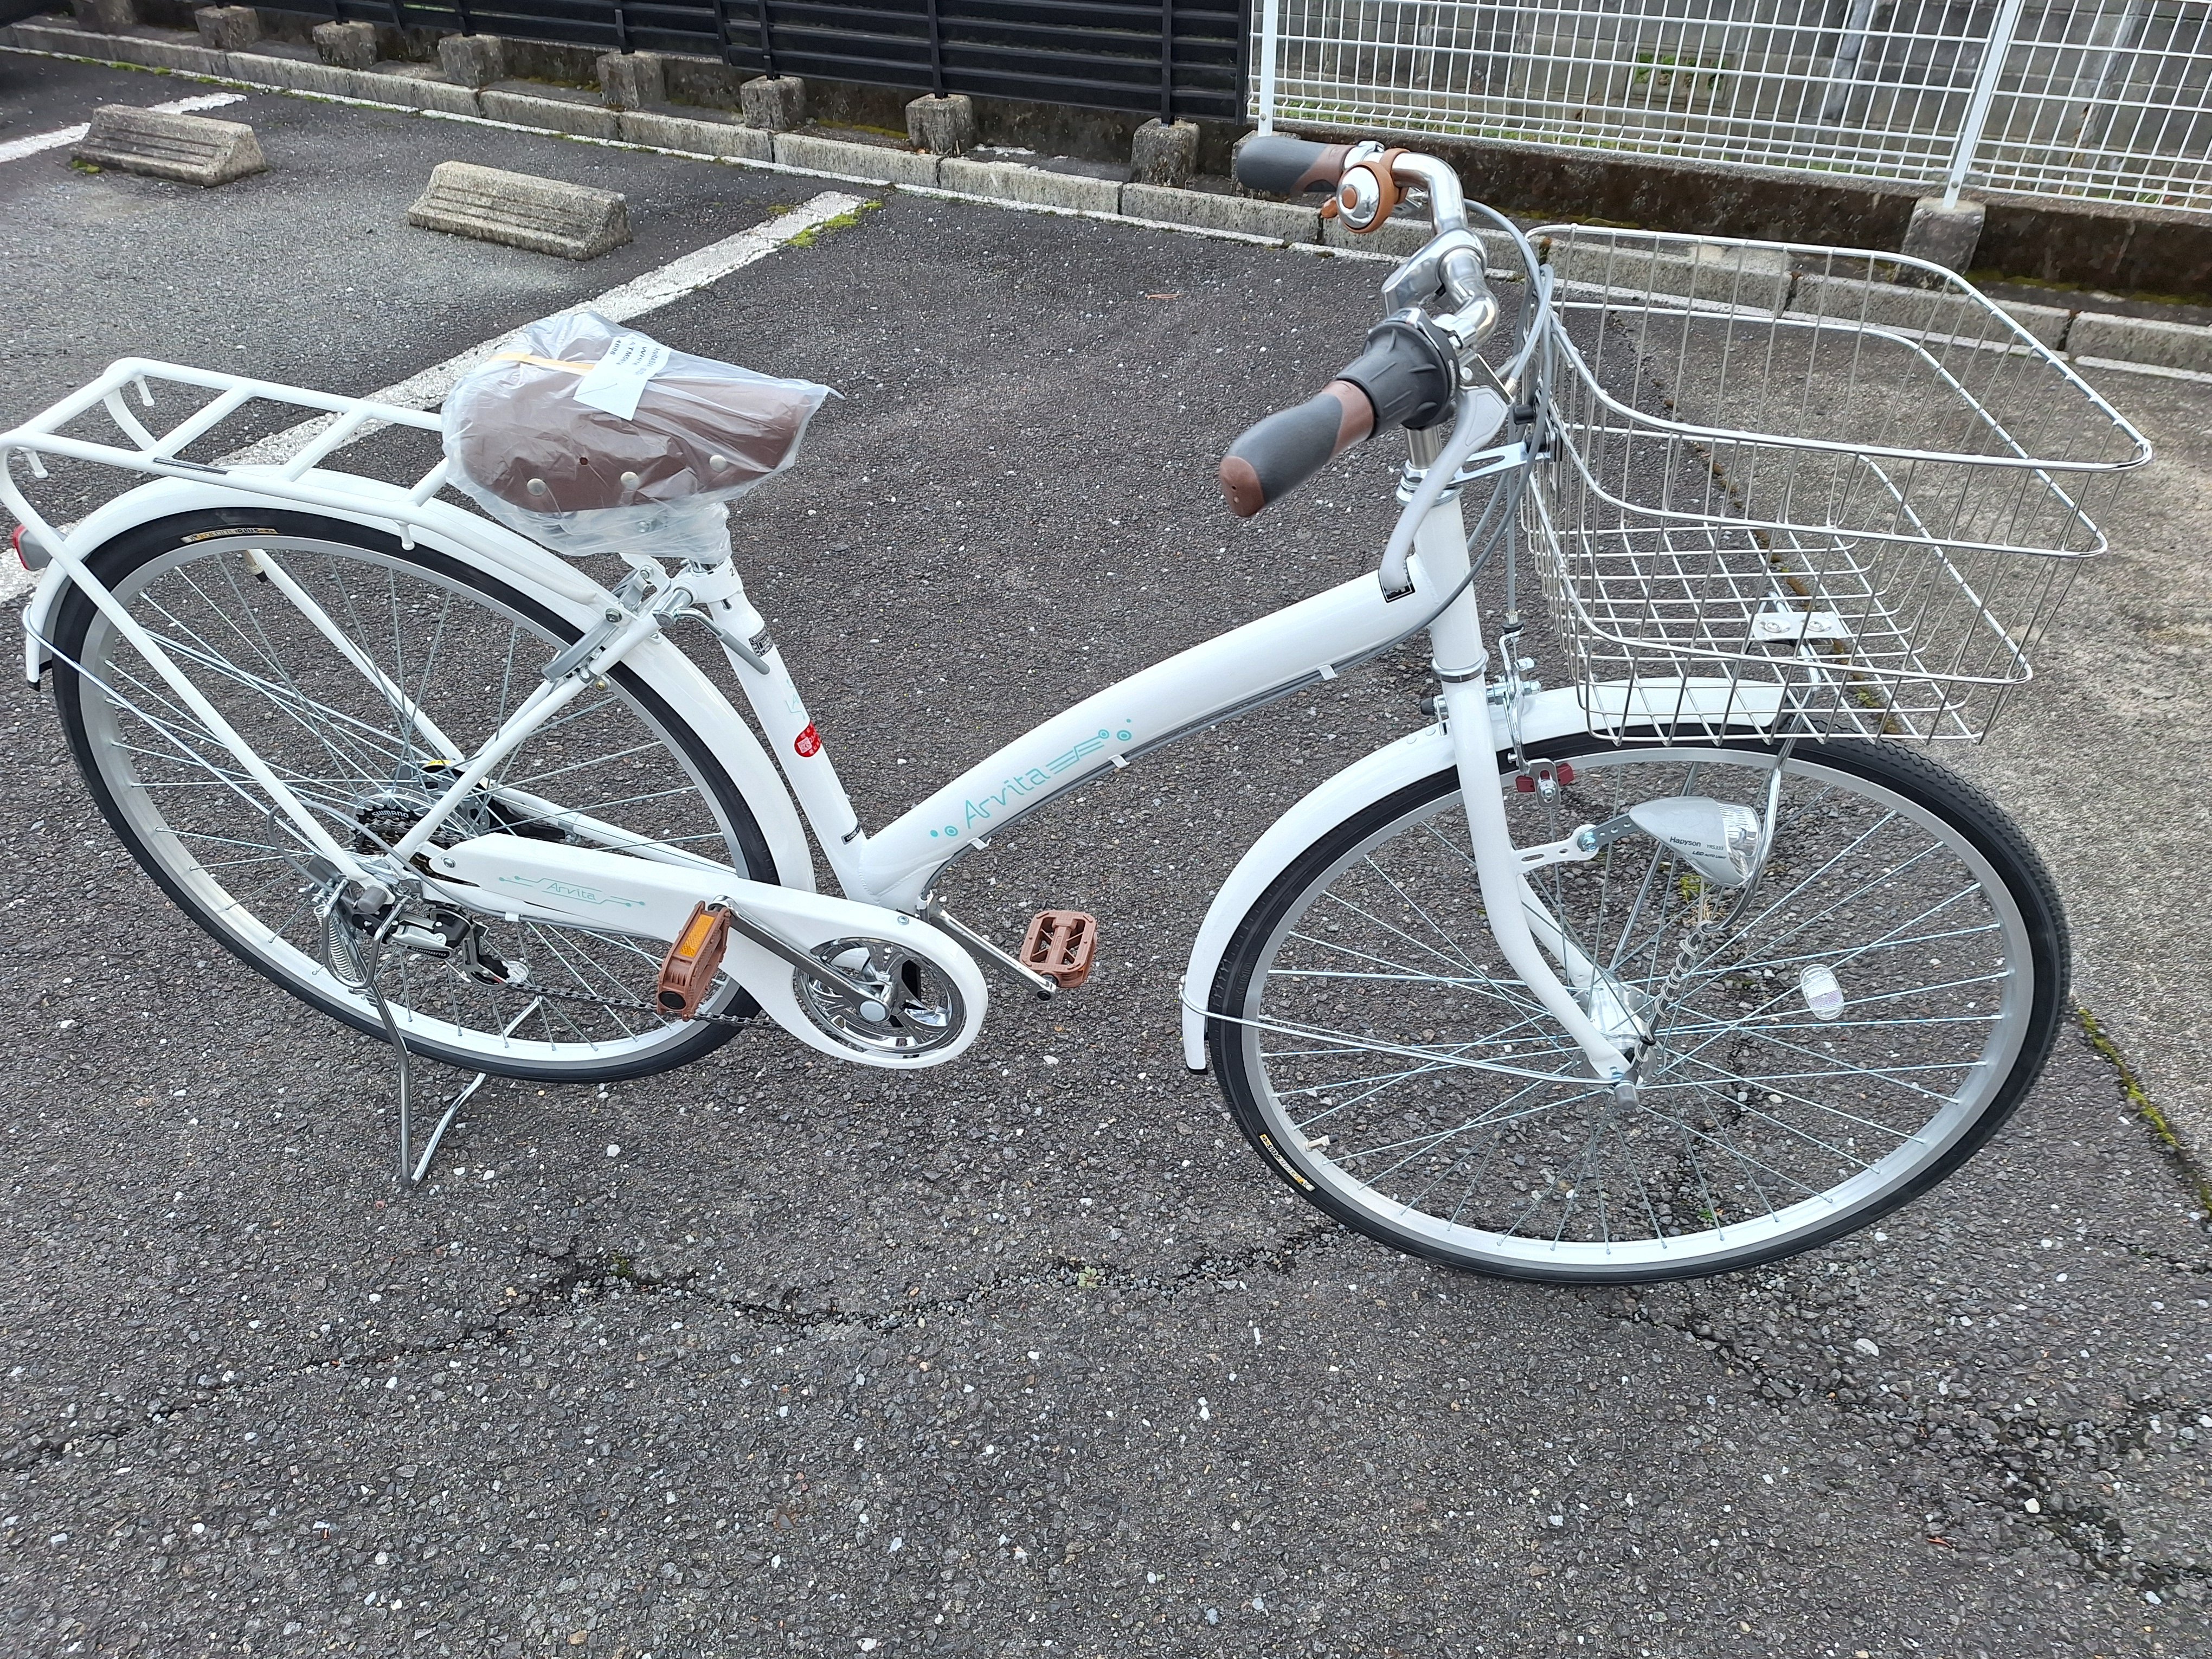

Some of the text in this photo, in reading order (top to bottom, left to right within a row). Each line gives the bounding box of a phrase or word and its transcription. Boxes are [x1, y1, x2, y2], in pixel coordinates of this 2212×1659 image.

[965, 768, 1051, 829] Arvita
[371, 810, 409, 818] SHIMANO
[1669, 835, 1701, 848] Hapyson
[546, 882, 596, 901] Arvita
[410, 947, 446, 956] SHIMANO
